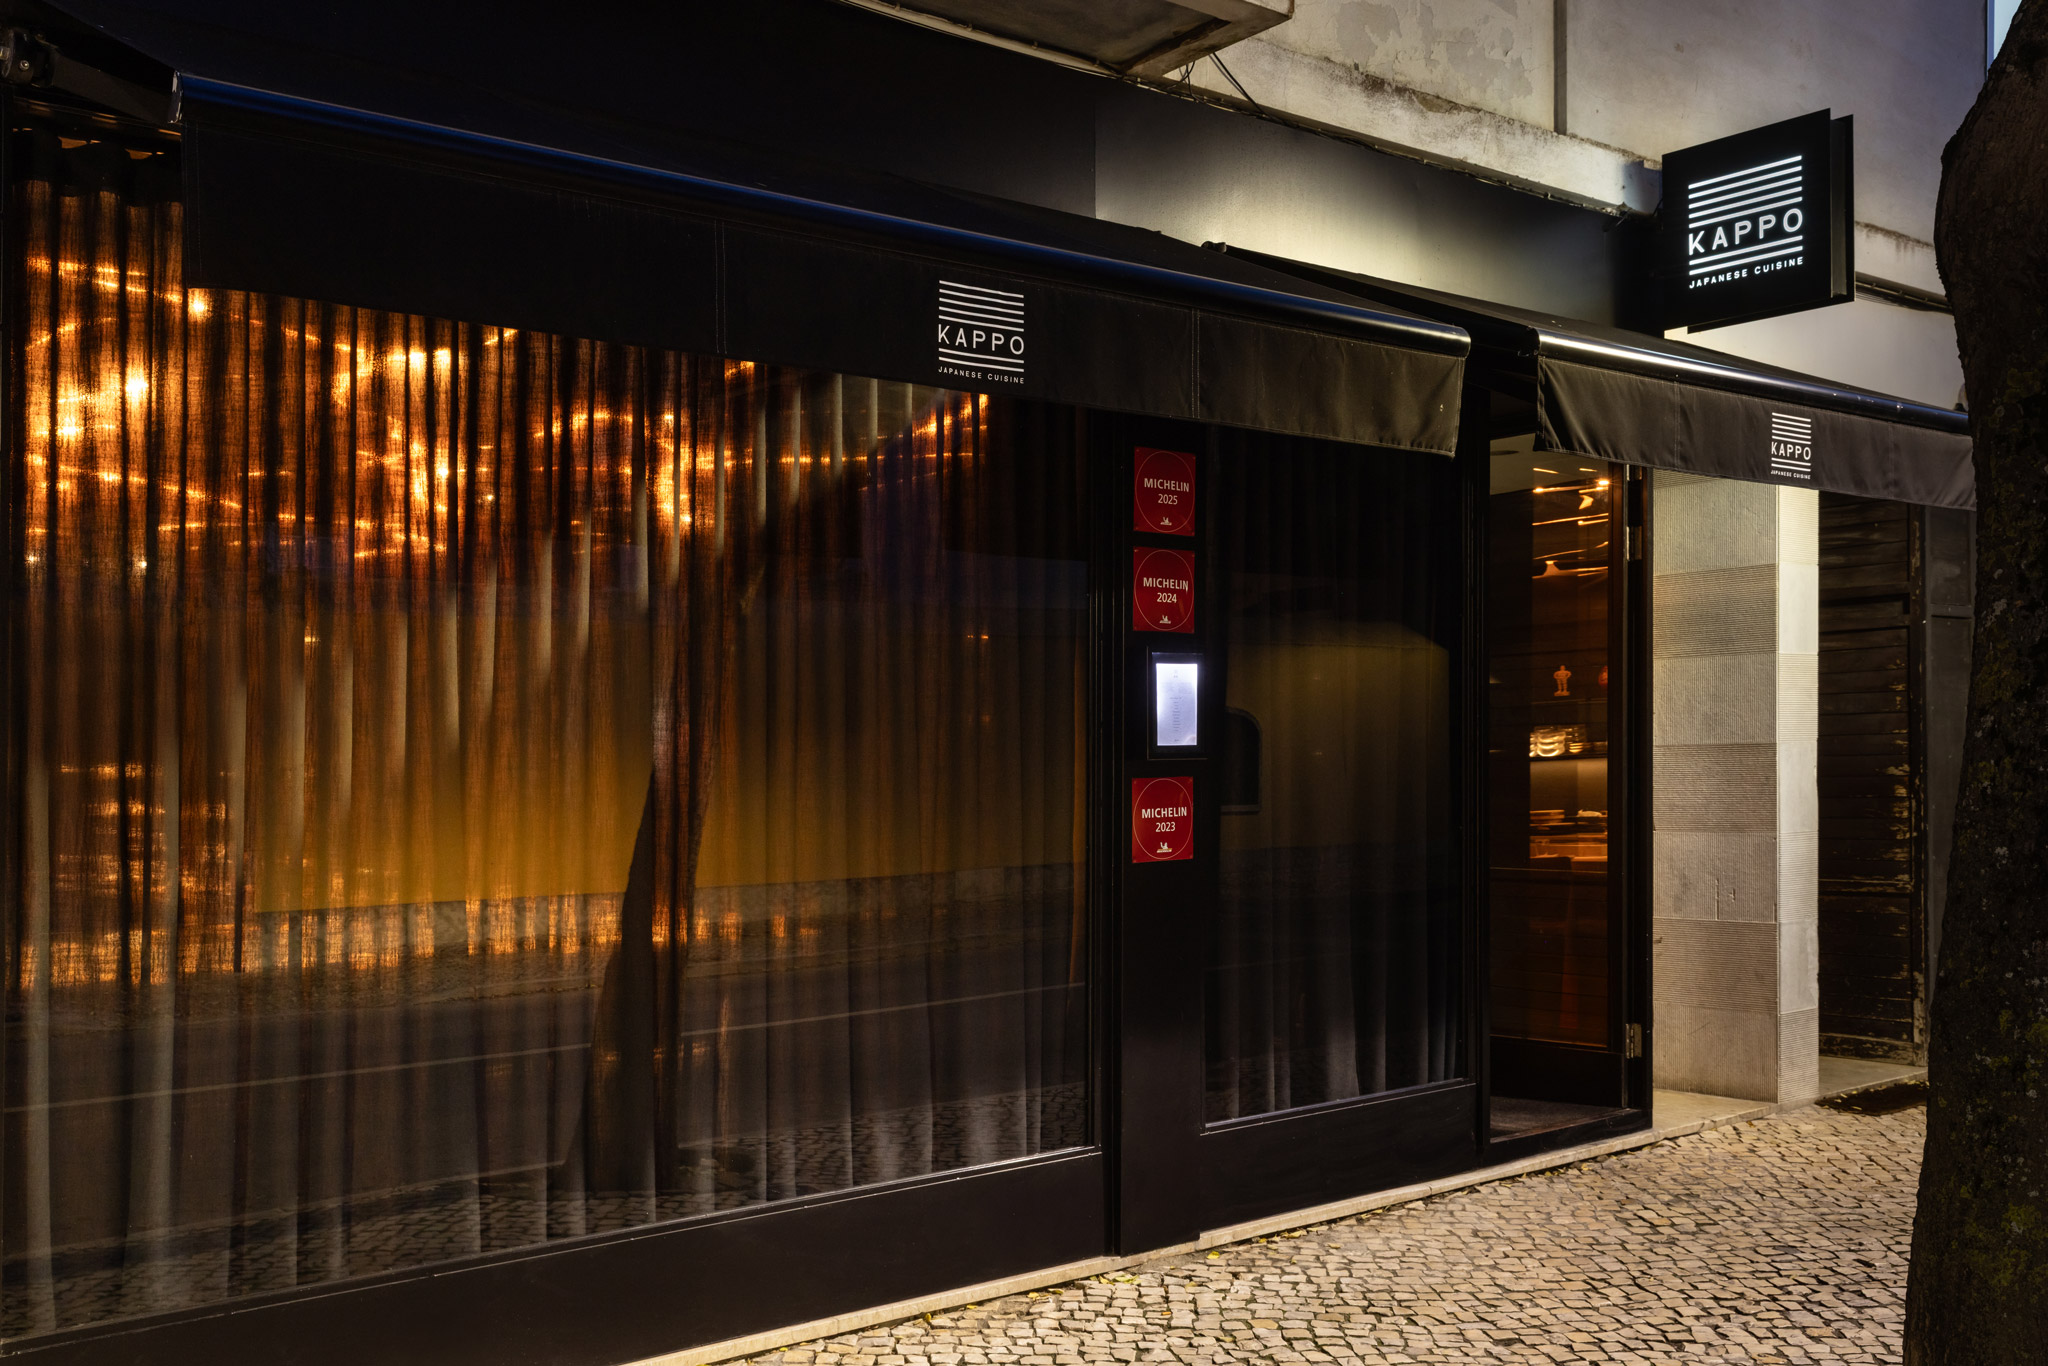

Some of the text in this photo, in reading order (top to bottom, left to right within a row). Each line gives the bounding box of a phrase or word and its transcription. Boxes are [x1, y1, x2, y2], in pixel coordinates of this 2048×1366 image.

[1688, 208, 1803, 256] KAPPO
[1689, 256, 1804, 289] JAPANESE CUISINE
[938, 323, 1025, 355] KAPPO
[938, 366, 1025, 385] JAPANESE CUISINE
[1771, 441, 1812, 461] KAPPO
[1143, 477, 1190, 493] MICHELIN
[1157, 493, 1178, 505] 2025
[1143, 577, 1189, 591] MICHELIN
[1156, 592, 1177, 603] 2024
[1141, 806, 1188, 819] MICHELIN
[1155, 821, 1176, 833] 2023
